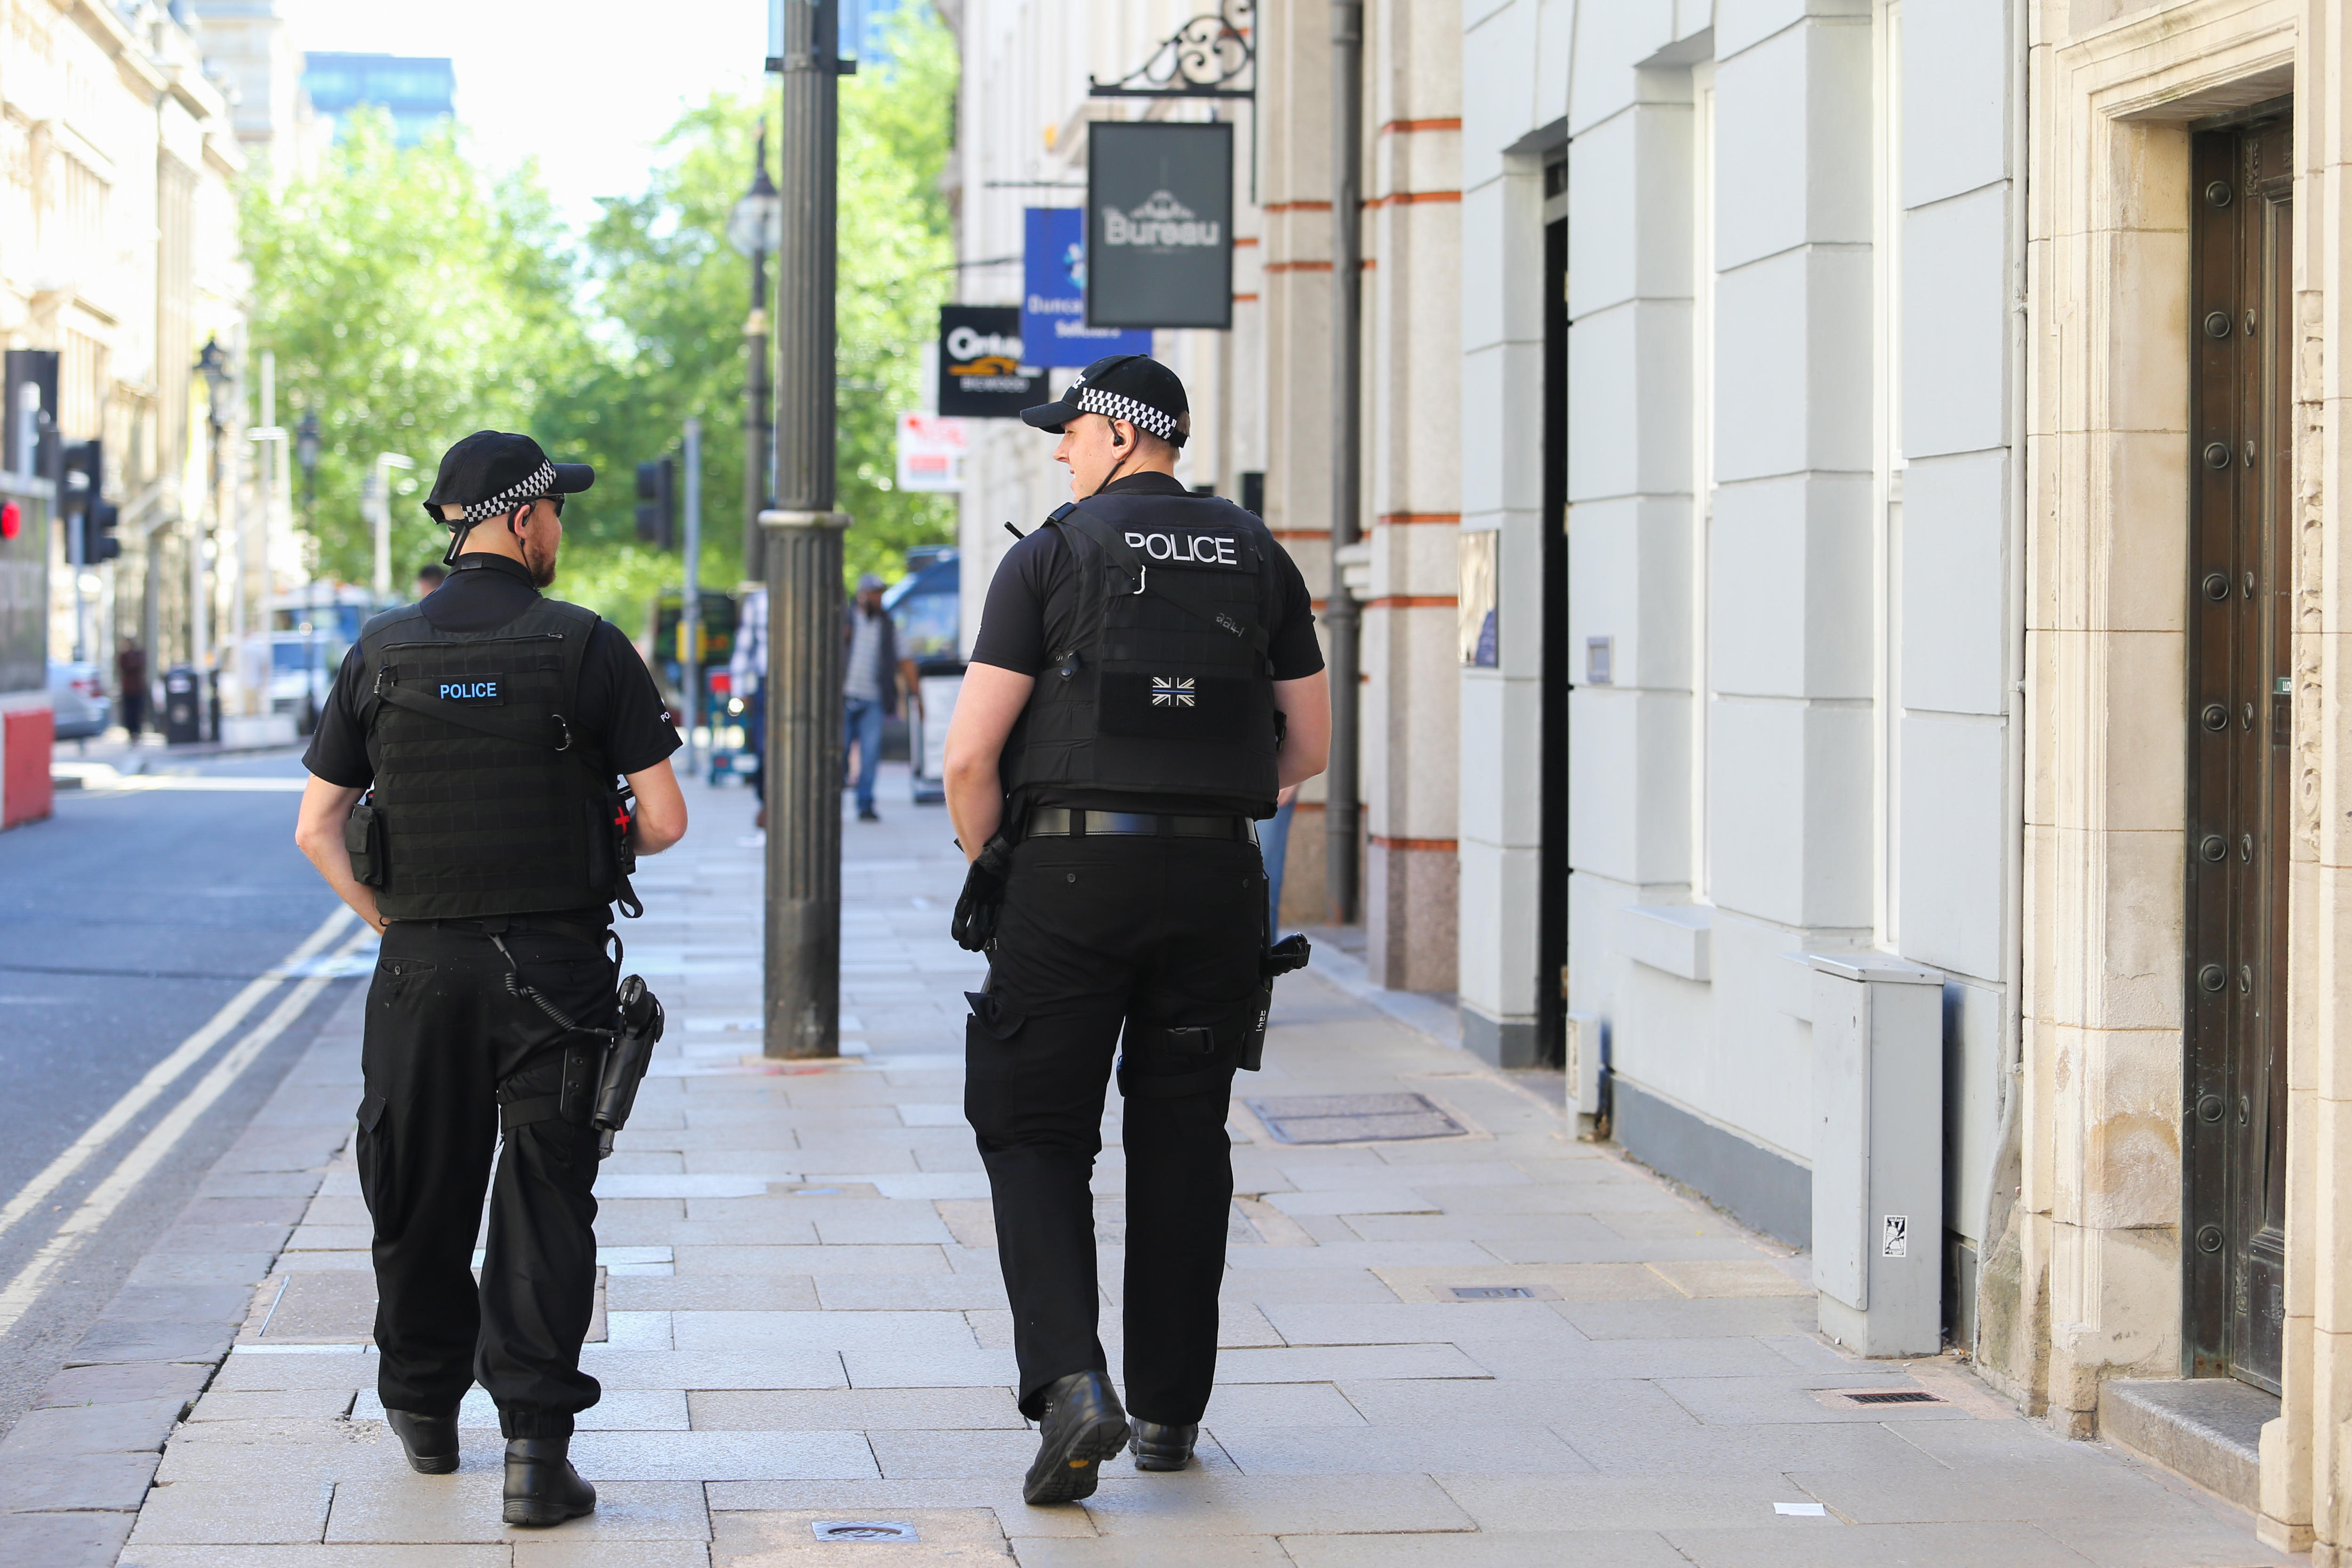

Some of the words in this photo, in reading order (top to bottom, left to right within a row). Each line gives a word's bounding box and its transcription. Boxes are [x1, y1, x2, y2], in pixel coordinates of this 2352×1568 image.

[1104, 212, 1220, 245] Bureau
[1027, 294, 1083, 315] Dunca
[1124, 532, 1237, 565] POLICE
[1216, 613, 1245, 637] 2241
[440, 682, 497, 699] POLICE
[2282, 681, 2291, 691] LLO
